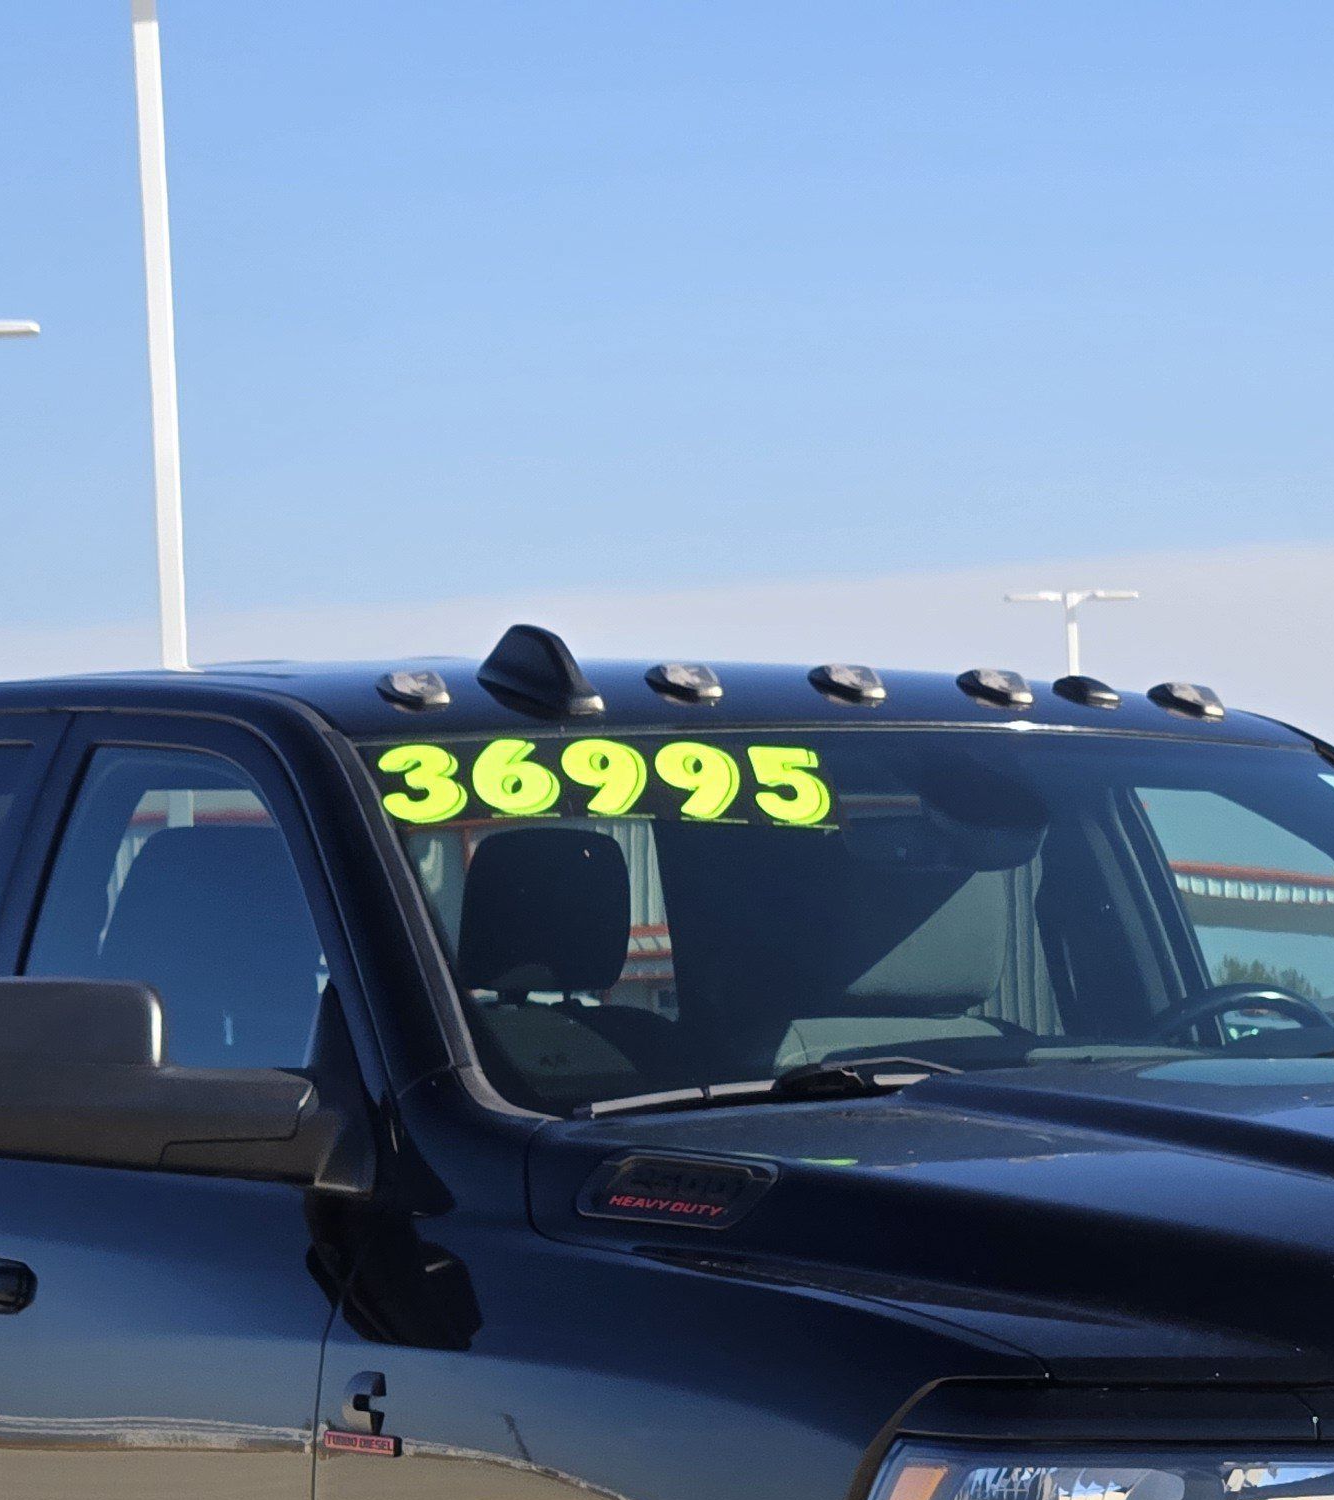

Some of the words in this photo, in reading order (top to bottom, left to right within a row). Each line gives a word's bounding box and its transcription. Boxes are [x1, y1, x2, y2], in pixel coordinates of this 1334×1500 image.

[378, 739, 831, 826] 36995
[608, 1194, 670, 1210] HEAVY
[668, 1200, 725, 1217] DUTY
